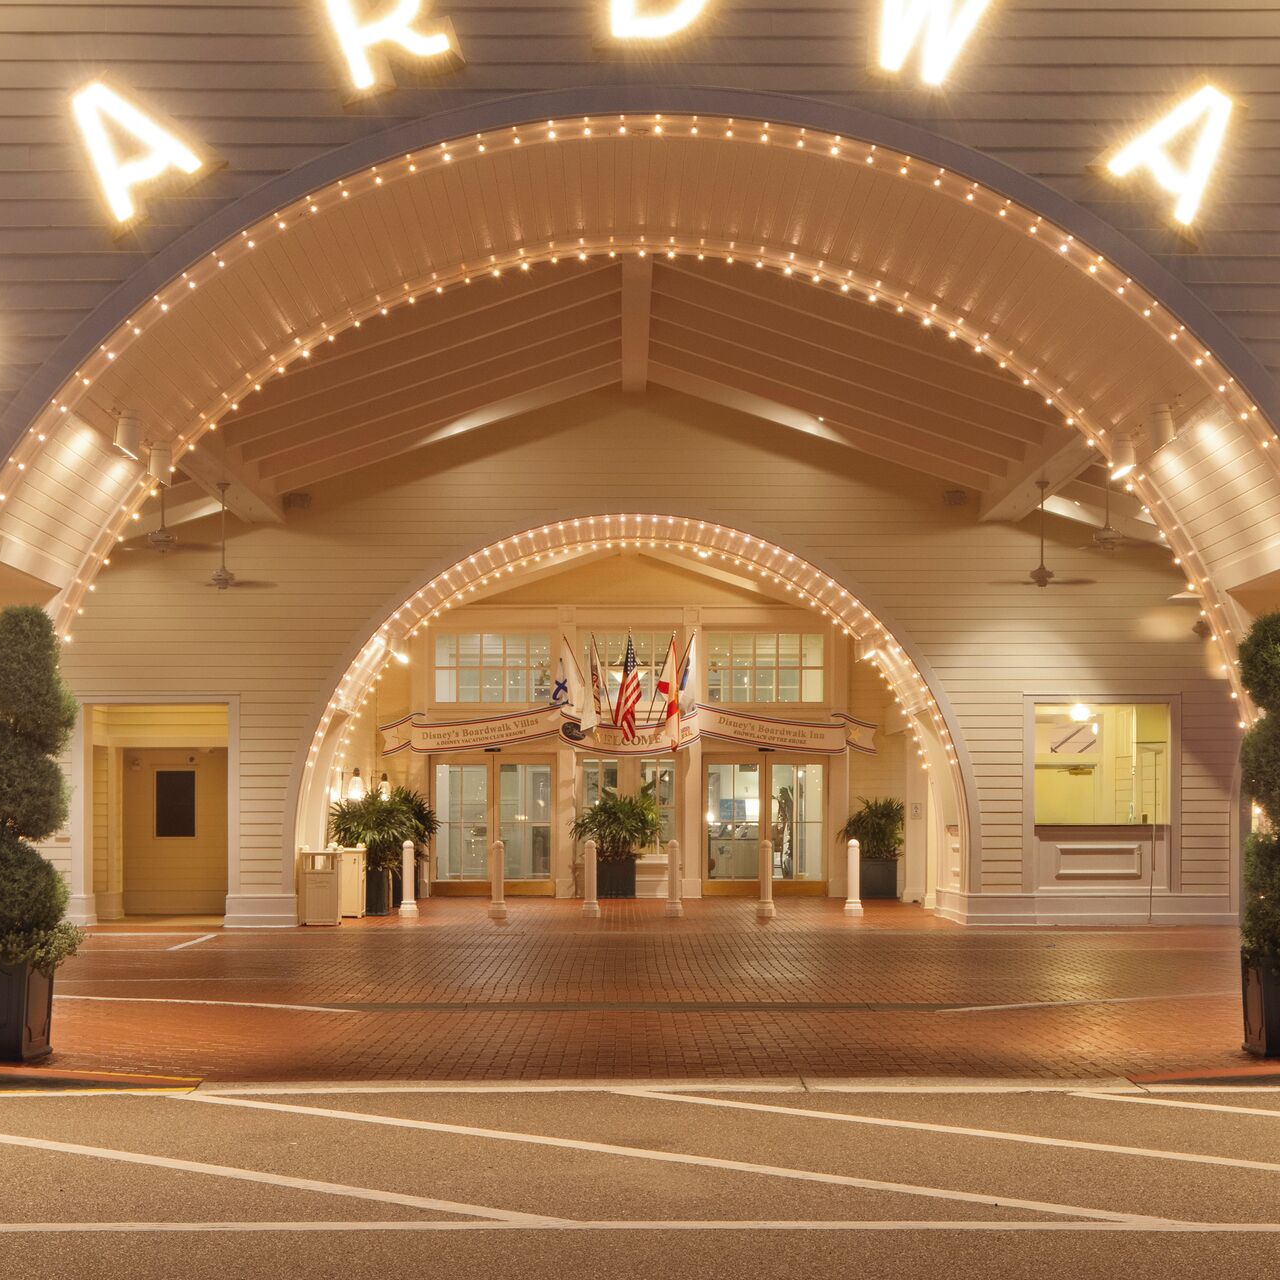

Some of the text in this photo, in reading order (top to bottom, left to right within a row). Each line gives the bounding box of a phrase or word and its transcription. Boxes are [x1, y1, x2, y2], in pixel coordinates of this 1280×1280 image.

[422, 718, 539, 741] Disney's Boardwalk Villas
[718, 716, 825, 740] Disney's Boardwalk Inn
